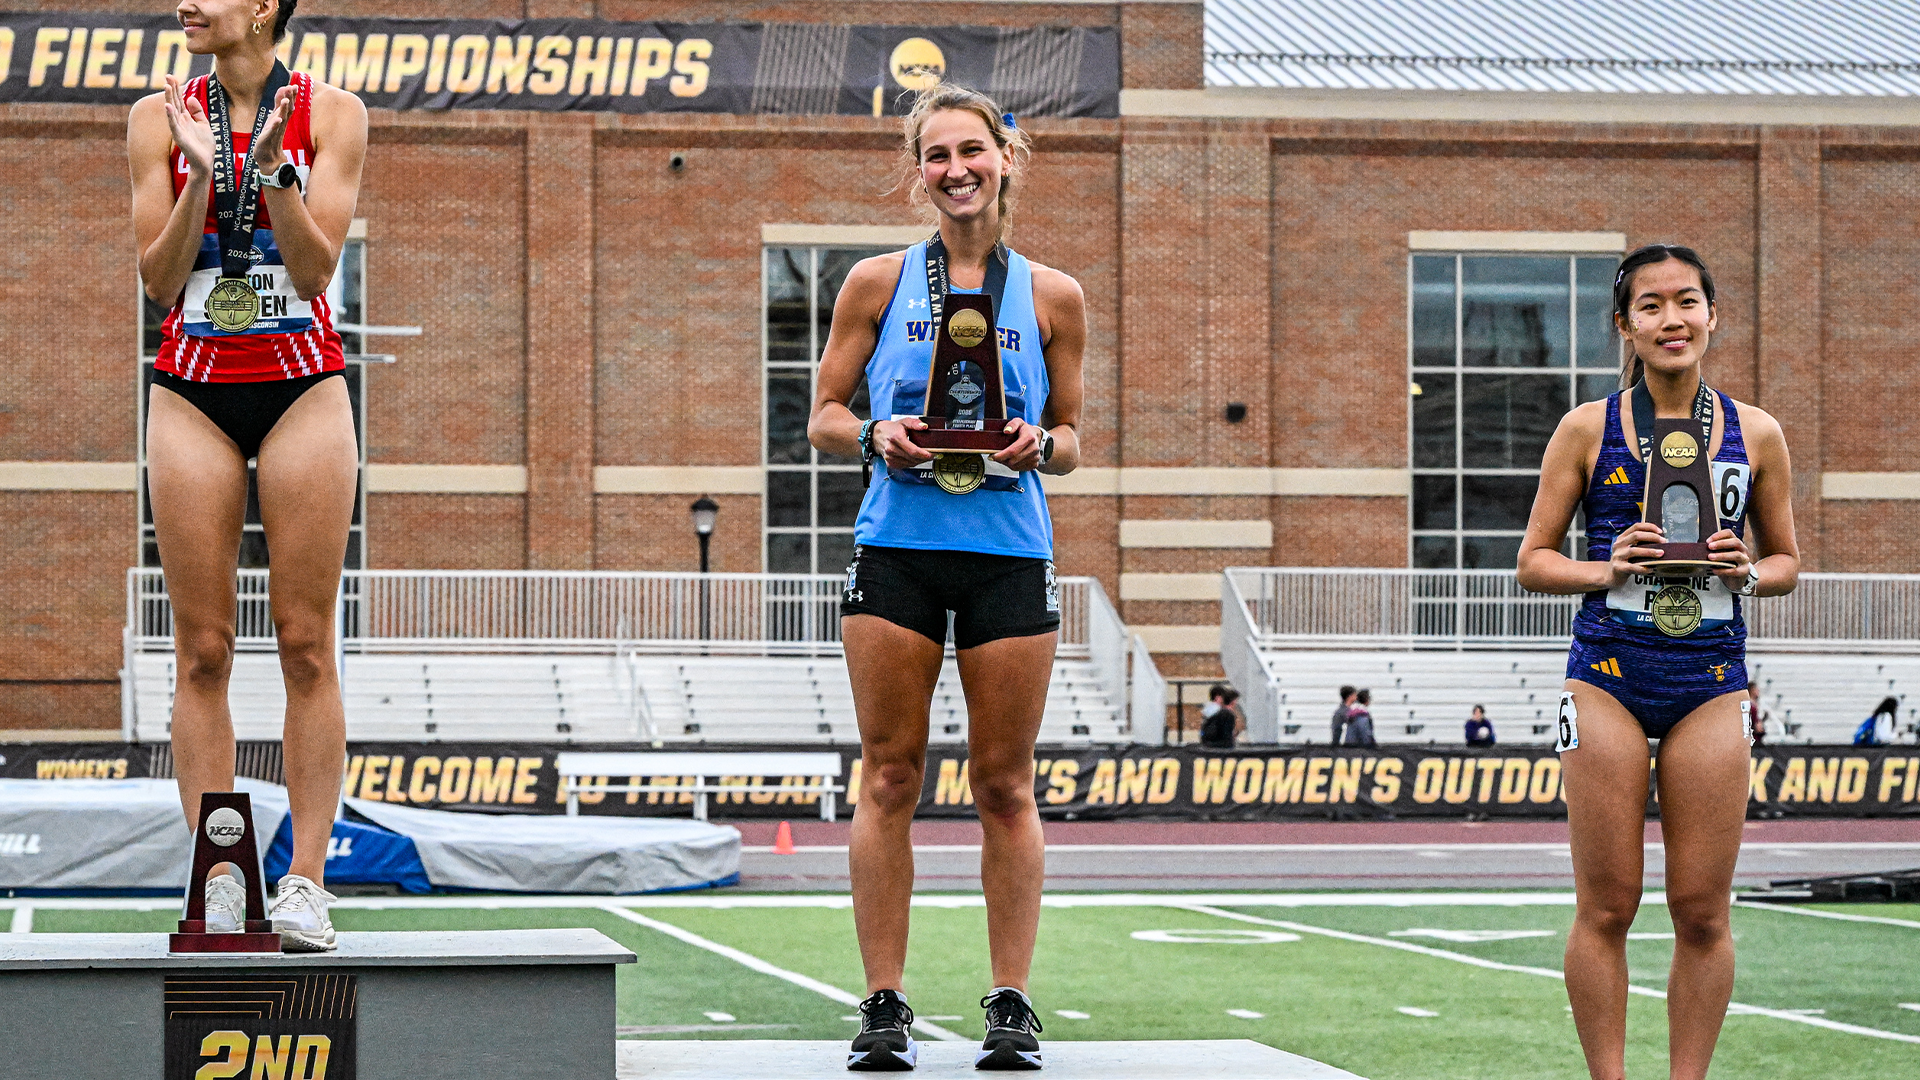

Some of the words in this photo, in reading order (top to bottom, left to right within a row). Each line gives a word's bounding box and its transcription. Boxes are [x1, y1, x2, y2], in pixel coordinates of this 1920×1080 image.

[28, 27, 194, 90] FIELD
[275, 33, 714, 97] AMPIONSHIPS
[258, 106, 267, 122] FIELD
[222, 122, 230, 151] OUTDOOR
[218, 210, 234, 218] 202
[227, 249, 248, 259] 2026
[951, 326, 987, 338] NCAA
[1664, 447, 1696, 458] NCAA
[1720, 468, 1740, 518] 6
[1634, 574, 1710, 591] CHANE
[1559, 696, 1572, 748] 6
[36, 760, 128, 778] WOMEN'S
[934, 758, 1079, 804] M'S
[1086, 758, 1181, 804] AND
[1193, 757, 1403, 804] WOMEN'S
[1412, 757, 1567, 803] OUTDO
[1778, 757, 1869, 803] AND
[1878, 757, 1920, 803] FI
[209, 825, 243, 837] NCAA
[195, 1030, 331, 1080] 2ND
